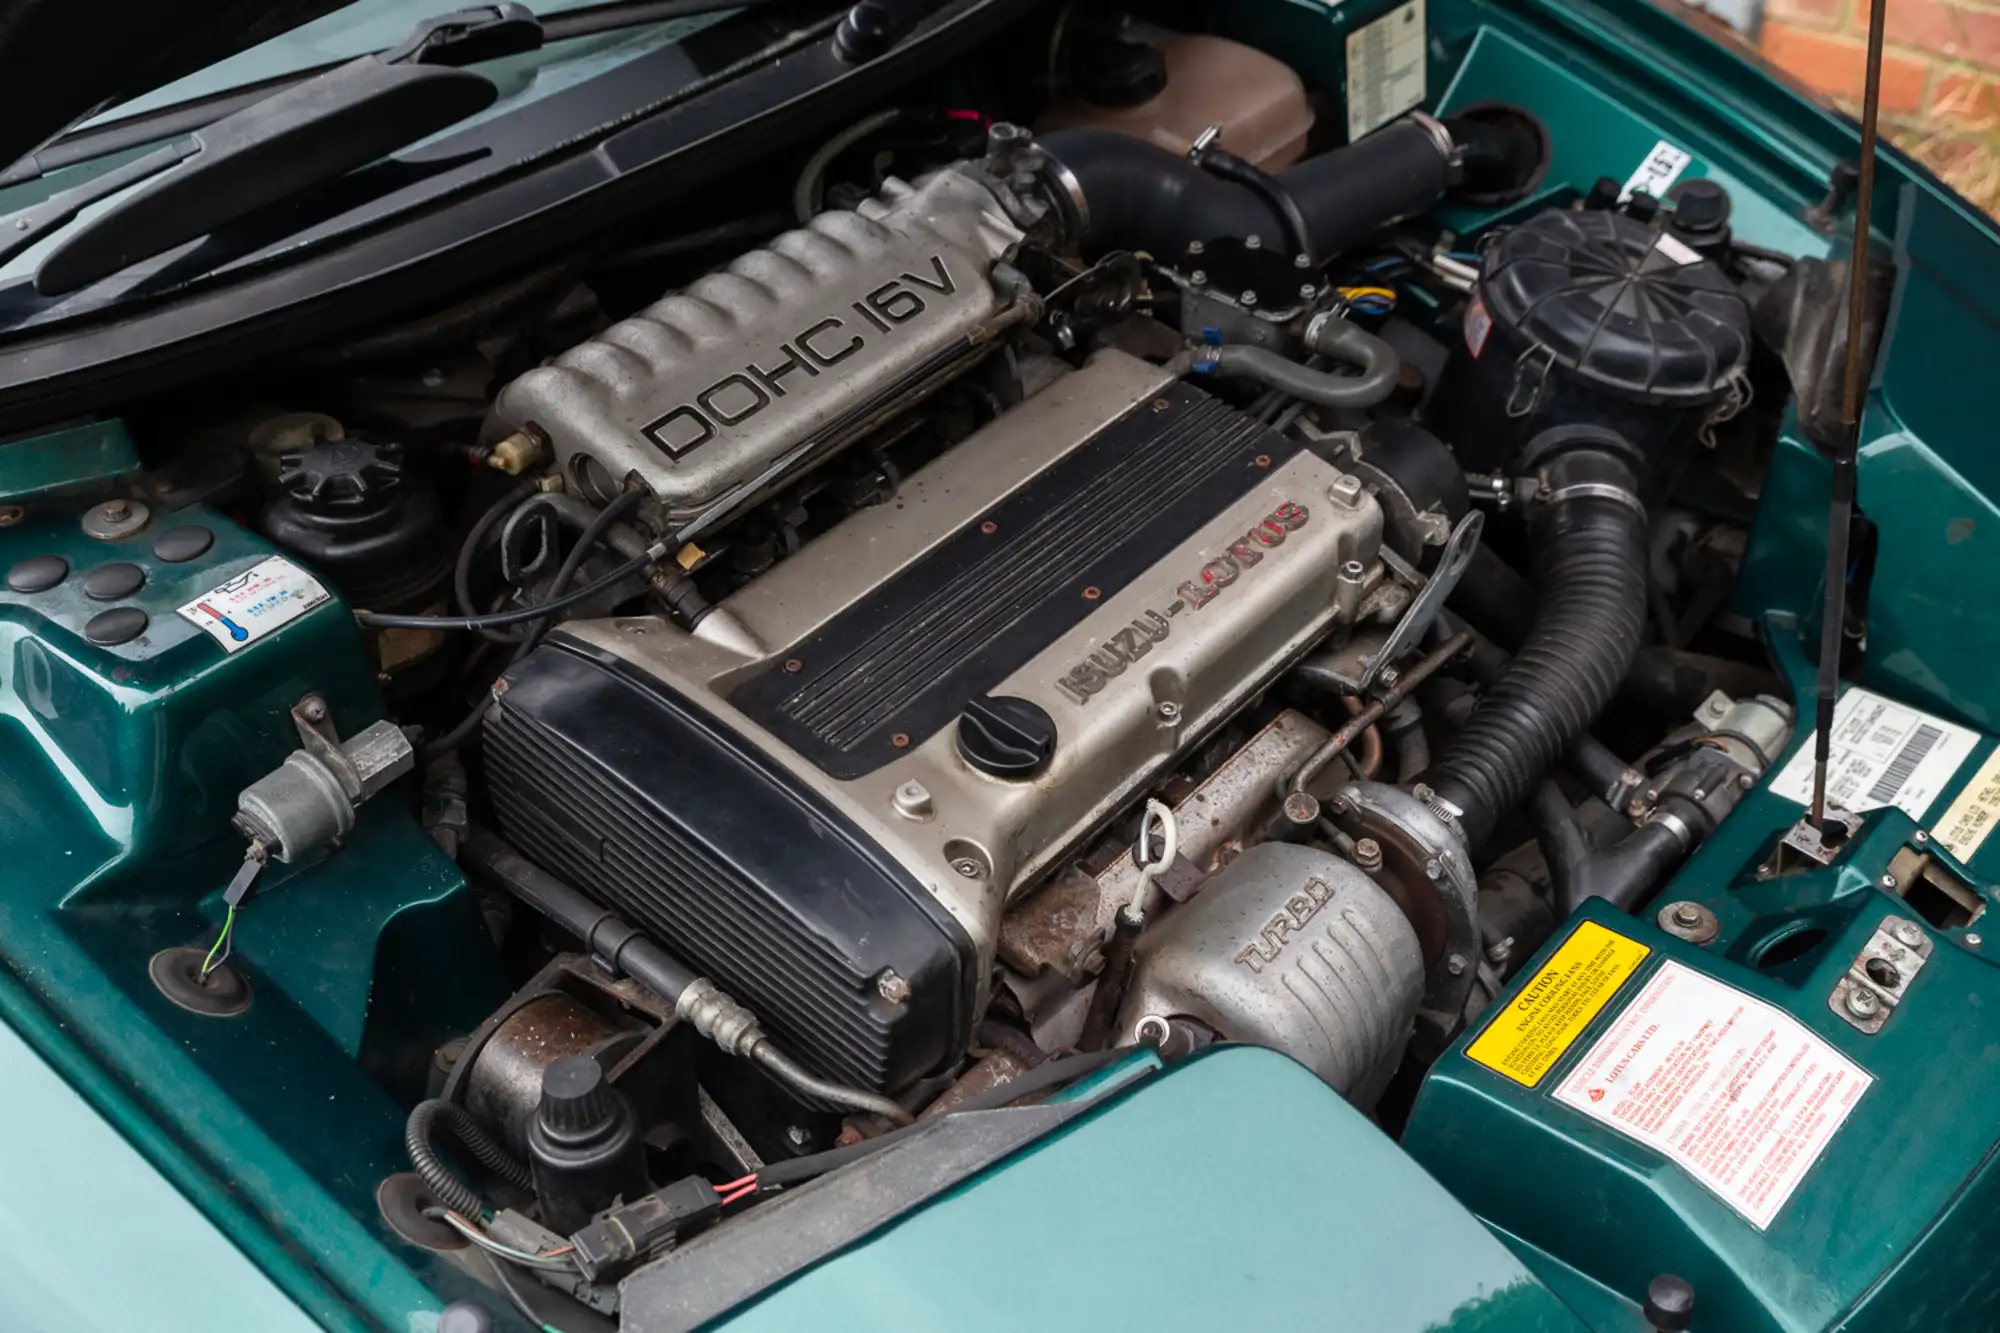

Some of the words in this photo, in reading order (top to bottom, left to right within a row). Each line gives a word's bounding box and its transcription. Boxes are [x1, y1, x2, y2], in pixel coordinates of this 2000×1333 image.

[640, 317, 865, 462] DOHC
[852, 254, 957, 335] 16V
[1234, 876, 1335, 973] TURBO
[1515, 1006, 1542, 1032] ENGINE
[1536, 976, 1569, 1008] COOLING
[1563, 960, 1583, 978] FANS
[1516, 969, 1559, 1012] CAUTION
[1604, 1057, 1631, 1083] LOTUS
[1624, 1038, 1647, 1059] CARS
